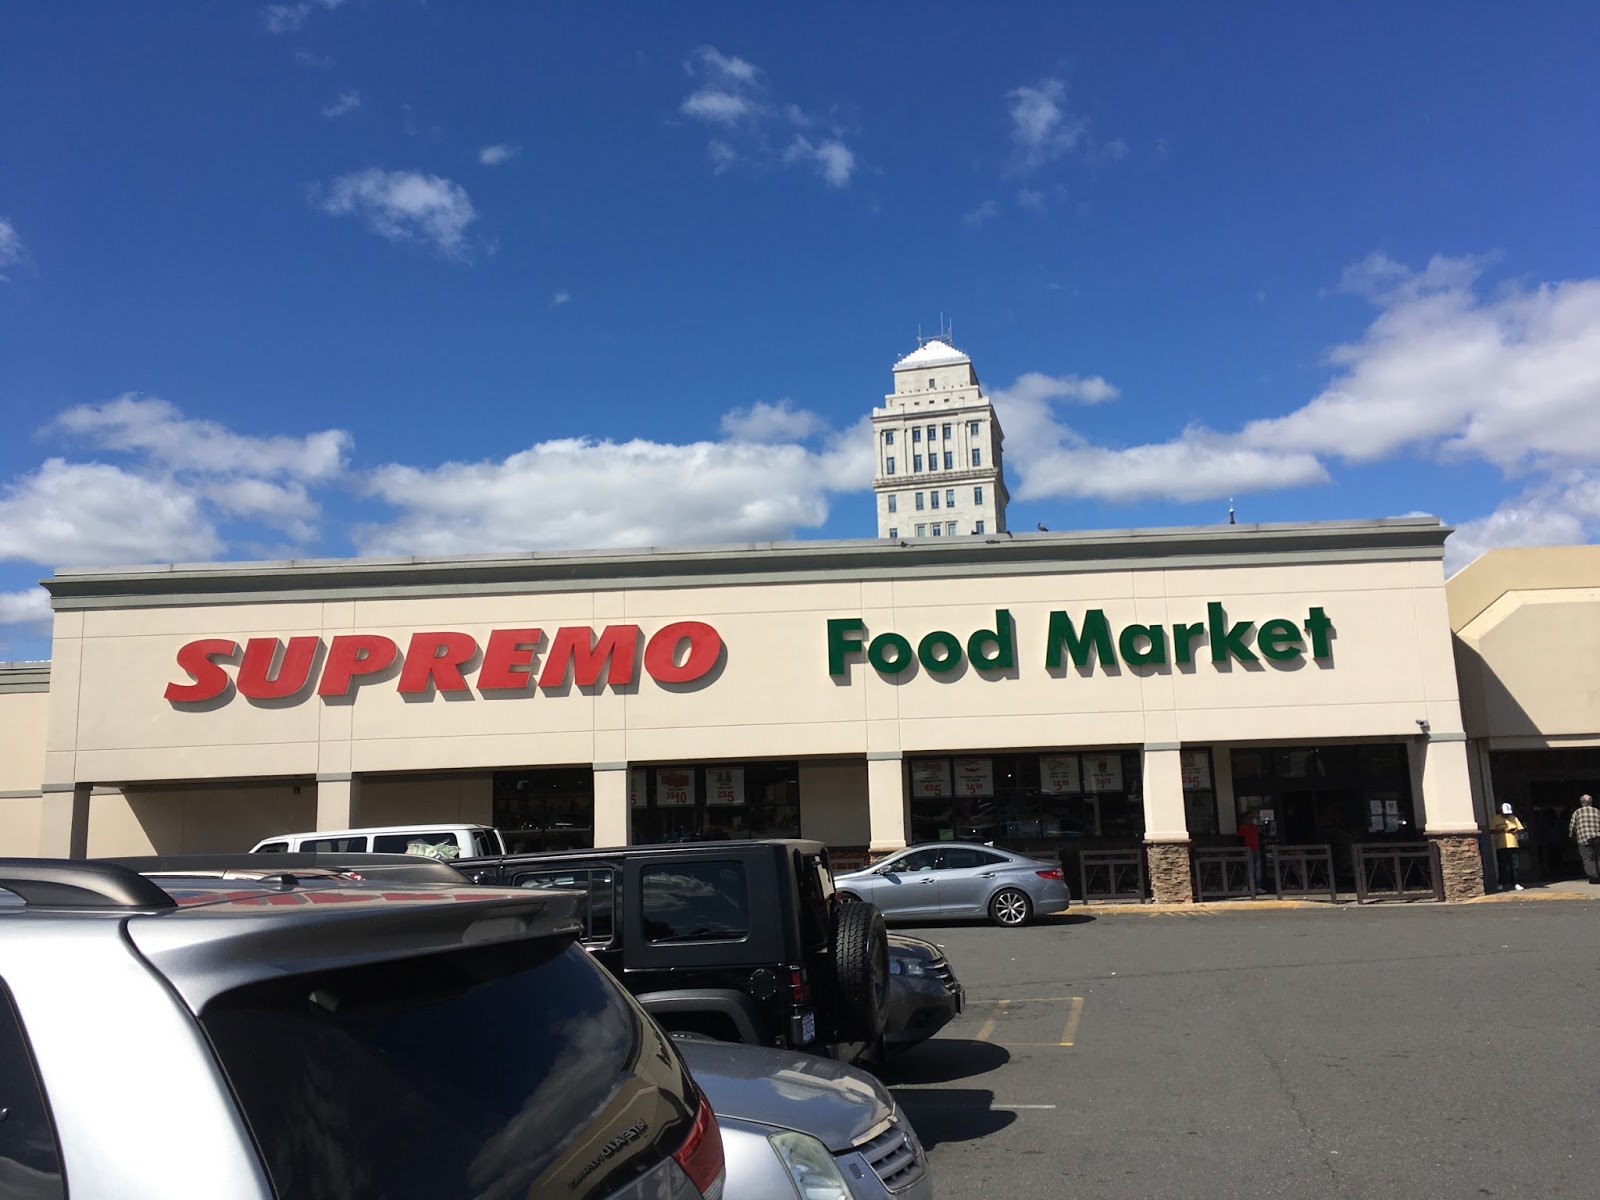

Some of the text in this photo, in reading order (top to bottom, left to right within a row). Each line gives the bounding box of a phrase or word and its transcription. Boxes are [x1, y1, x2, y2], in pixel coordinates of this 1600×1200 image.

[164, 621, 721, 701] SUPREMO
[827, 602, 1332, 675] Food Market
